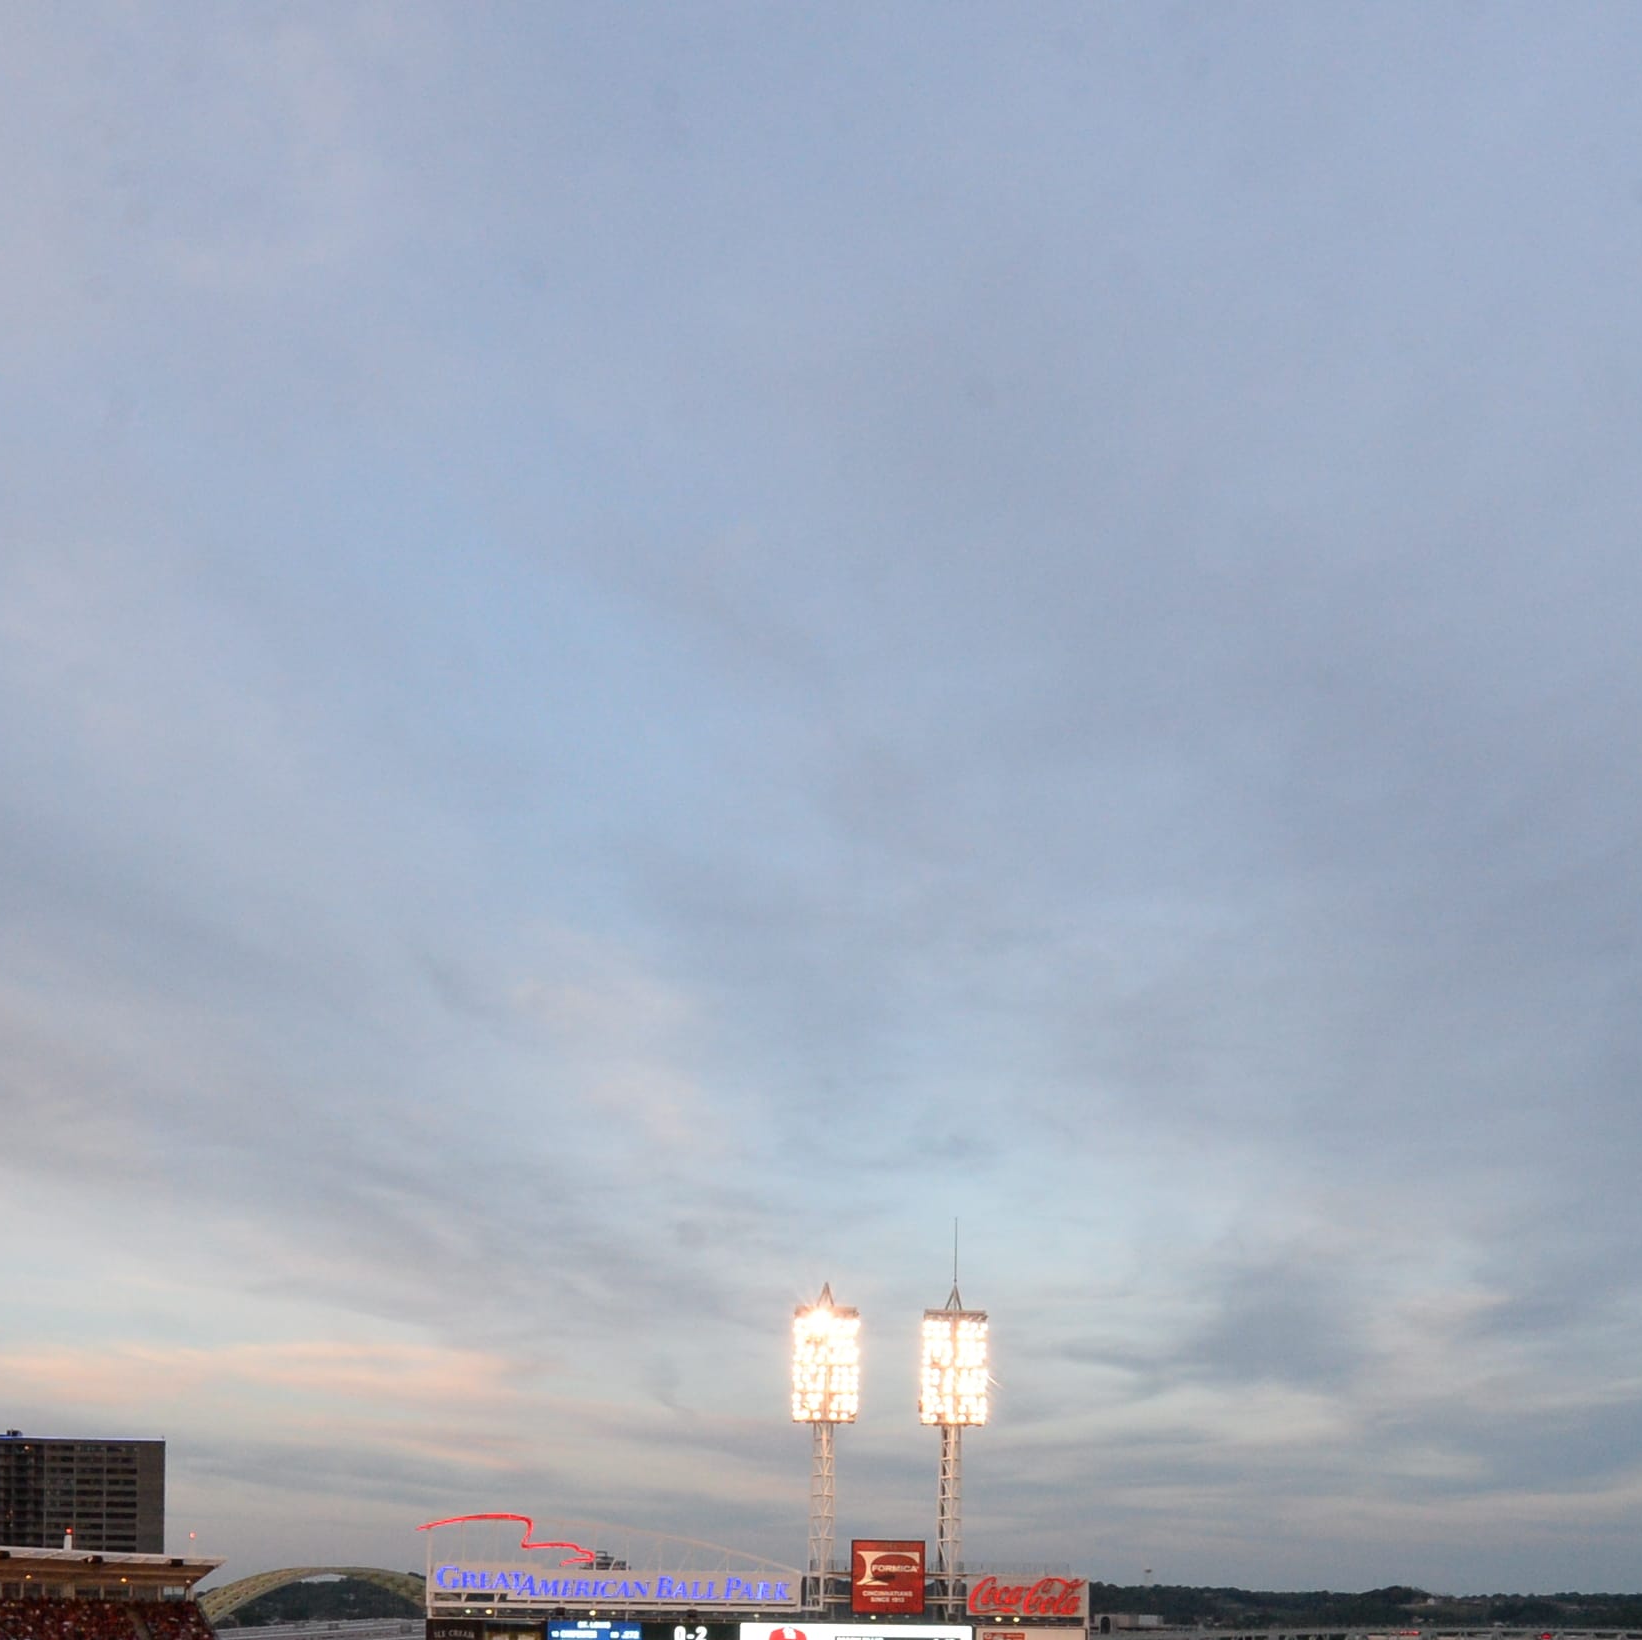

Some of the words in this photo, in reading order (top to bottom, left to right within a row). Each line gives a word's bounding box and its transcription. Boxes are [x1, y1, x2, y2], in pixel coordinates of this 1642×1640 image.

[871, 1564, 919, 1574] FORMICA
[436, 1565, 525, 1590] GREAT
[516, 1574, 650, 1599] AMERICAN
[656, 1575, 720, 1601] BALL
[720, 1576, 793, 1601] PARK
